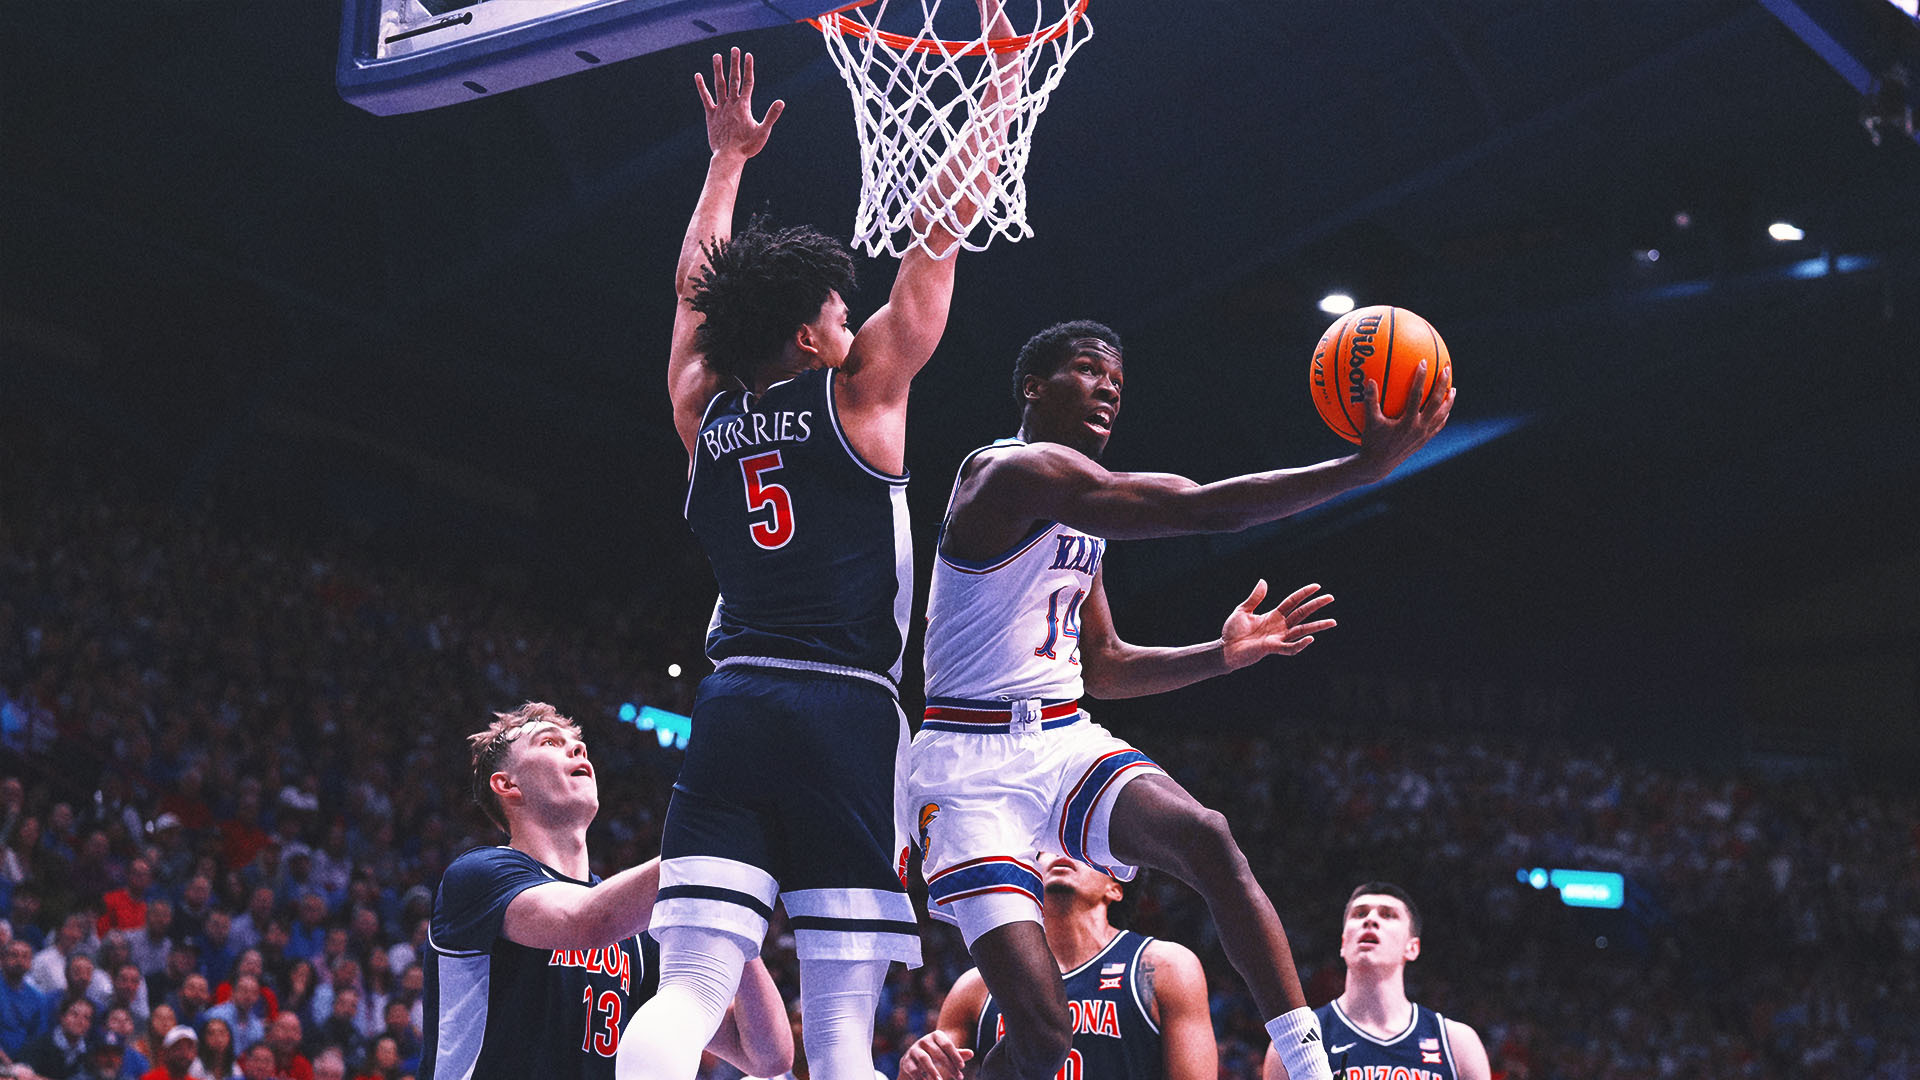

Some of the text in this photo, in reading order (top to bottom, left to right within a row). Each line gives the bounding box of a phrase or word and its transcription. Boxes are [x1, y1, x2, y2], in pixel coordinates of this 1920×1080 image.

[1349, 314, 1383, 404] Wilson
[703, 410, 812, 461] BURRIES
[738, 449, 796, 550] 5
[1048, 534, 1103, 577] KAN
[1034, 586, 1085, 666] 14
[582, 984, 621, 1058] 13
